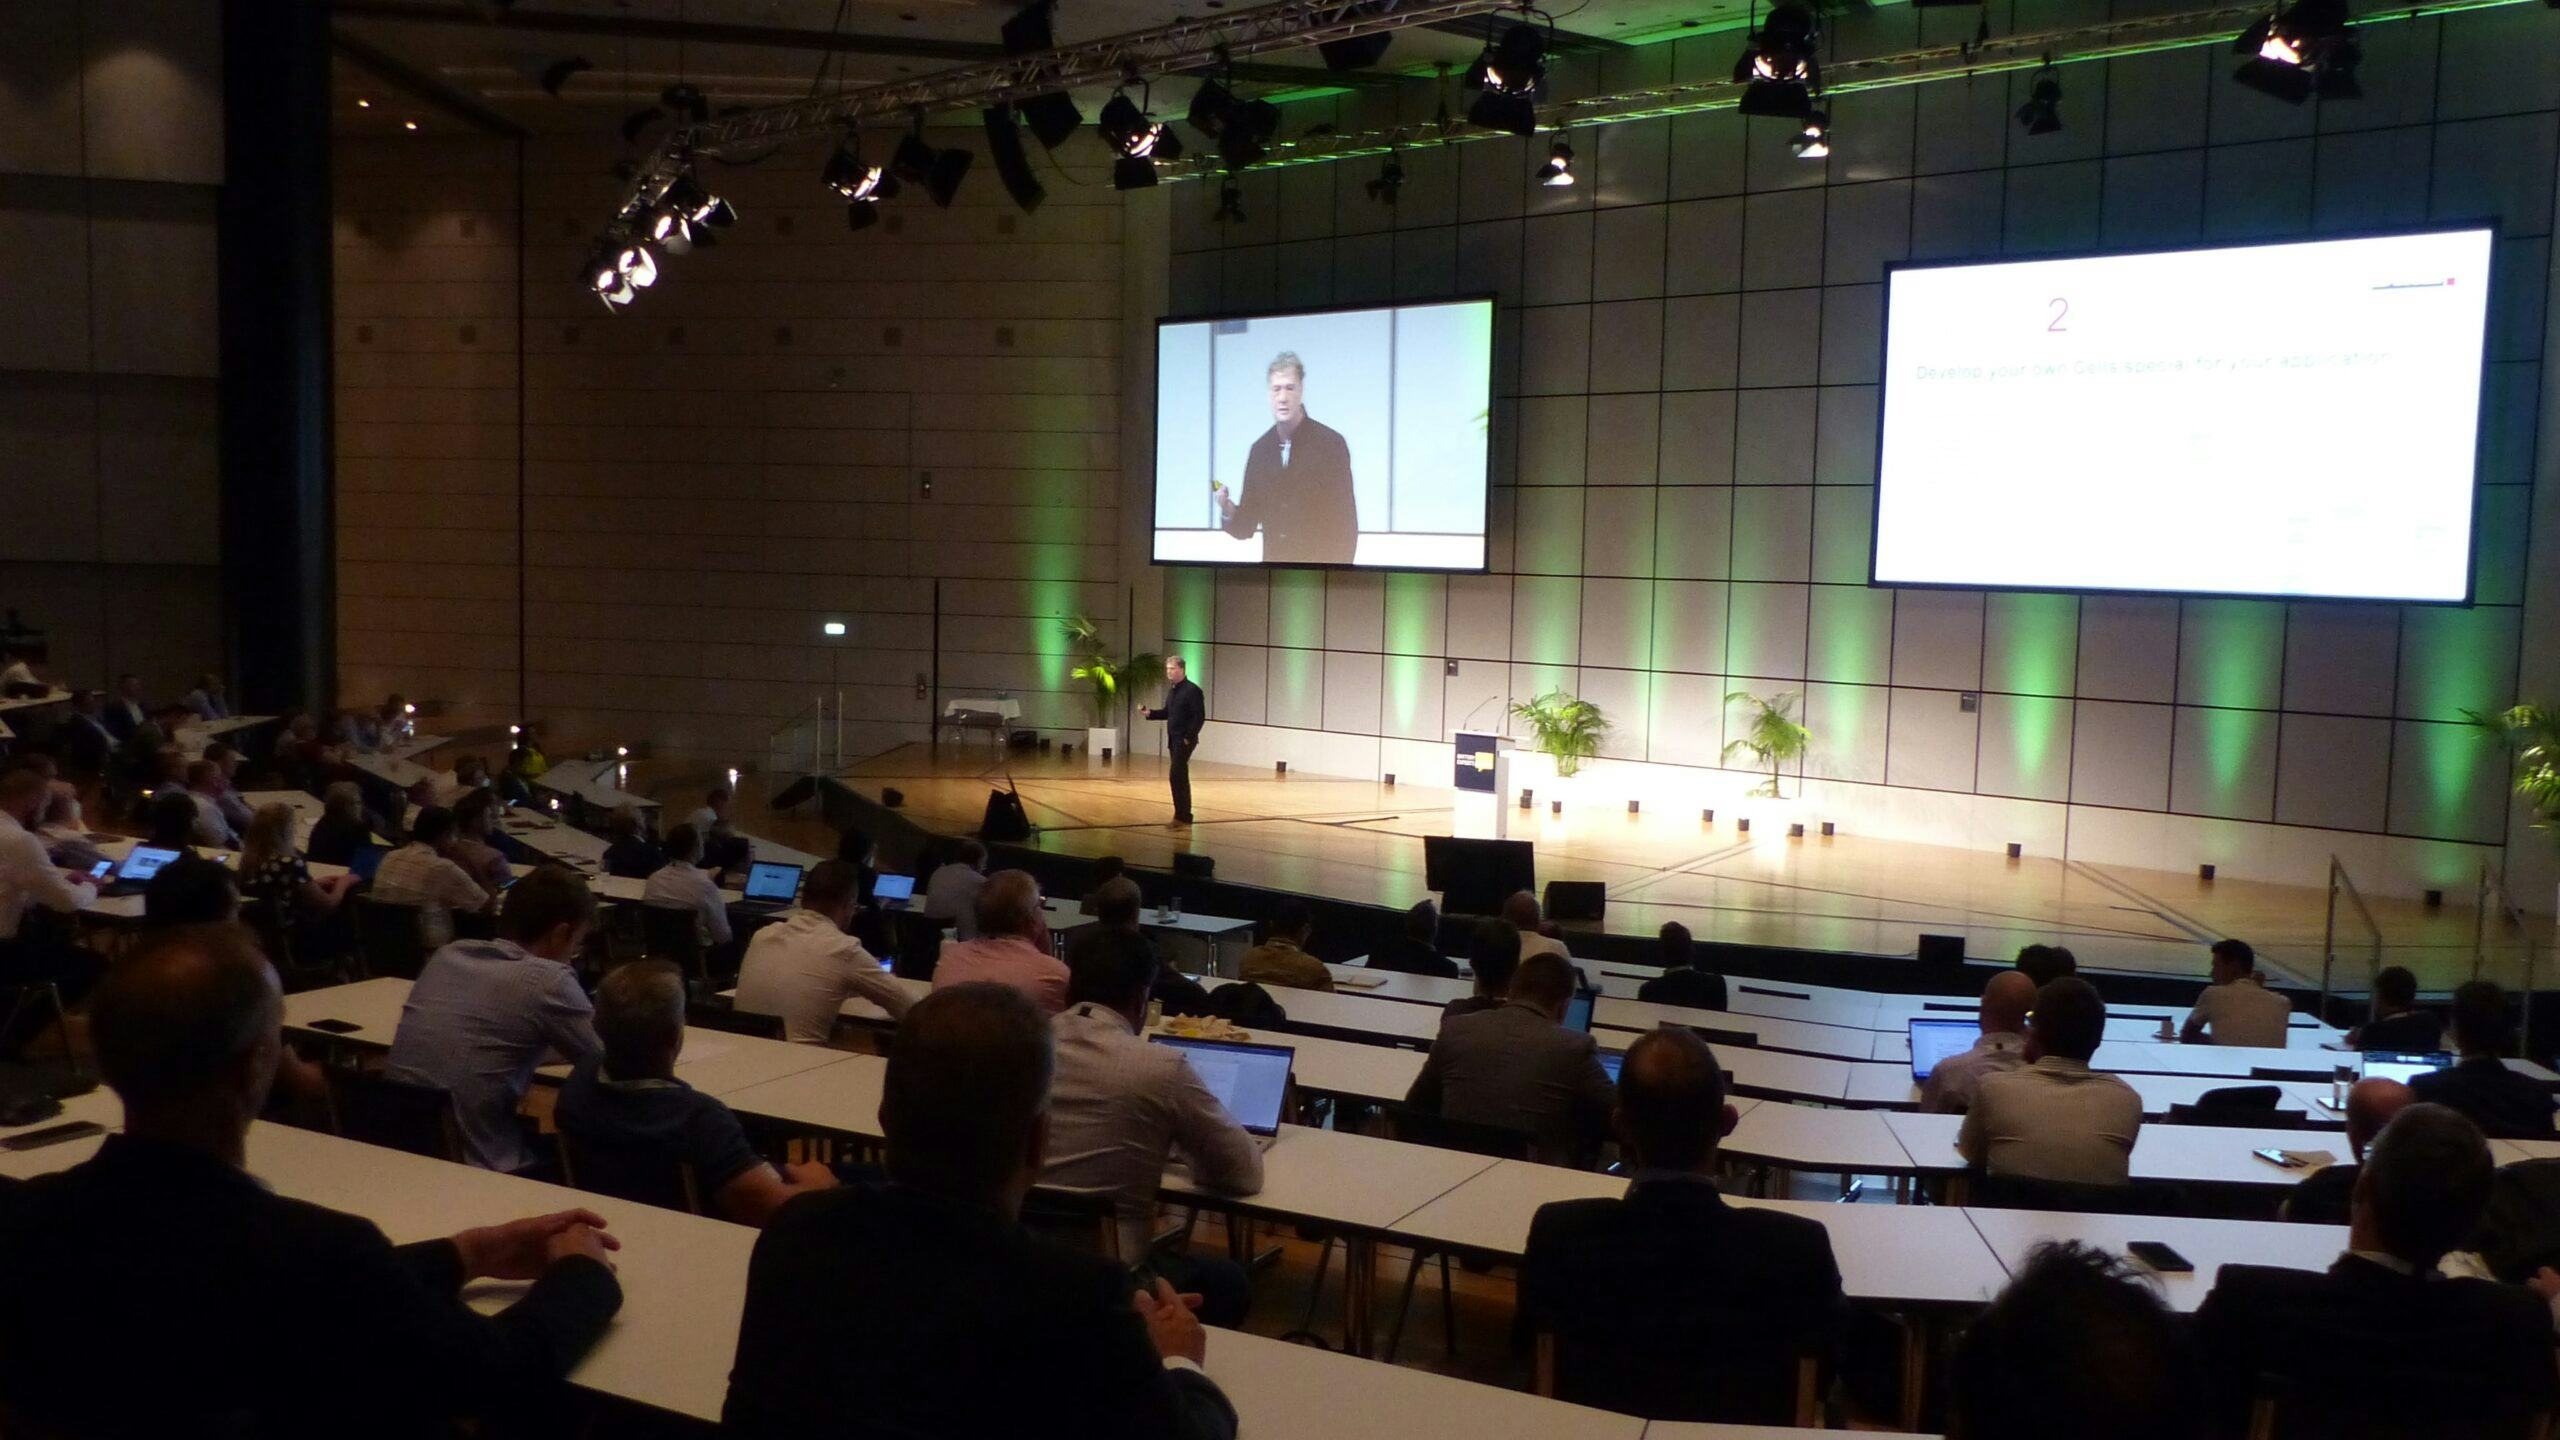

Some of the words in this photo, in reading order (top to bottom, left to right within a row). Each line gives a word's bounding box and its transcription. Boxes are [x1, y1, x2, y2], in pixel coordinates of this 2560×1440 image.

[2046, 297, 2070, 332] 2
[1916, 364, 1982, 382] Develop
[1987, 365, 2026, 383] your
